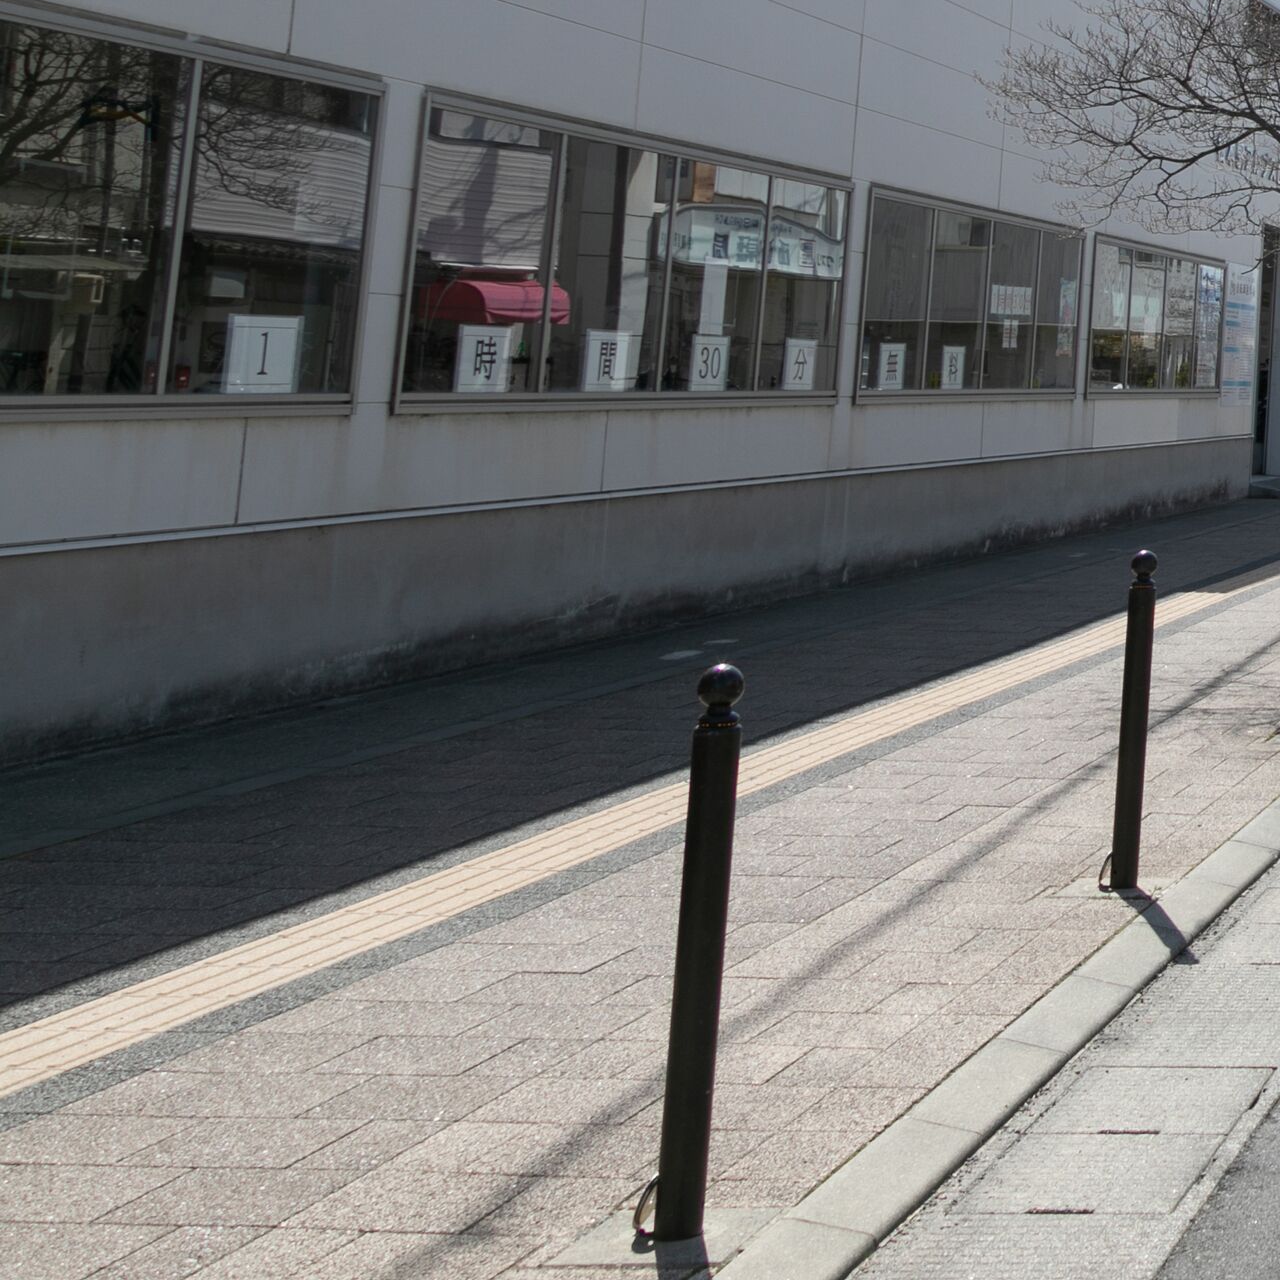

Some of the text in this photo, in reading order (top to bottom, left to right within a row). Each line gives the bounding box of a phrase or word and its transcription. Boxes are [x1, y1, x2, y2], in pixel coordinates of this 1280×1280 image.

[256, 331, 269, 376] 1
[472, 336, 498, 381] 時
[598, 341, 617, 382] 間
[699, 346, 721, 380] 30
[792, 348, 808, 381] 分
